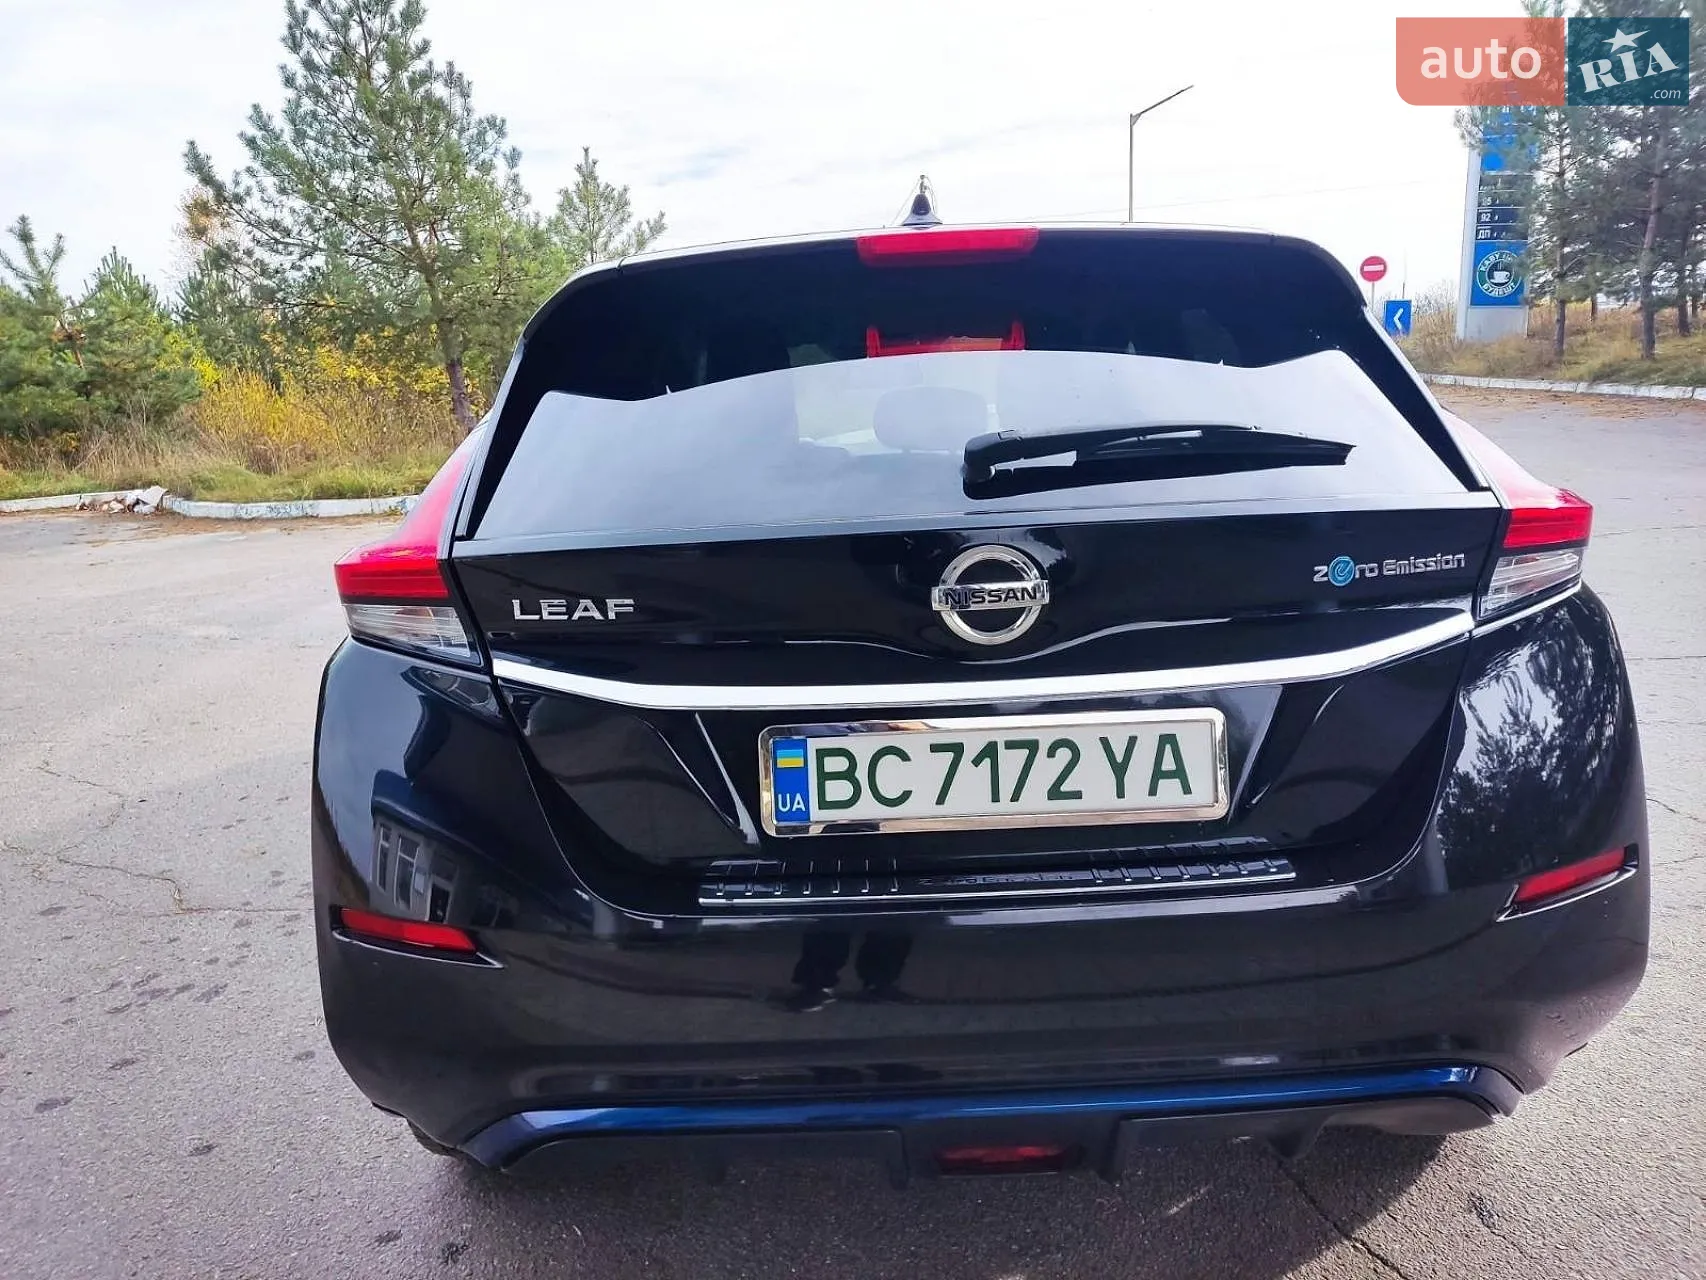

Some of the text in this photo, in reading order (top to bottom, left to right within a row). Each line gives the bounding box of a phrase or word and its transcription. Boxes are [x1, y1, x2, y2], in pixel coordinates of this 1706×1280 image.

[943, 586, 1038, 606] NISSAN
[511, 598, 635, 621] LEAF
[815, 733, 1193, 810] BC 7172 YA
[777, 792, 806, 812] UA
